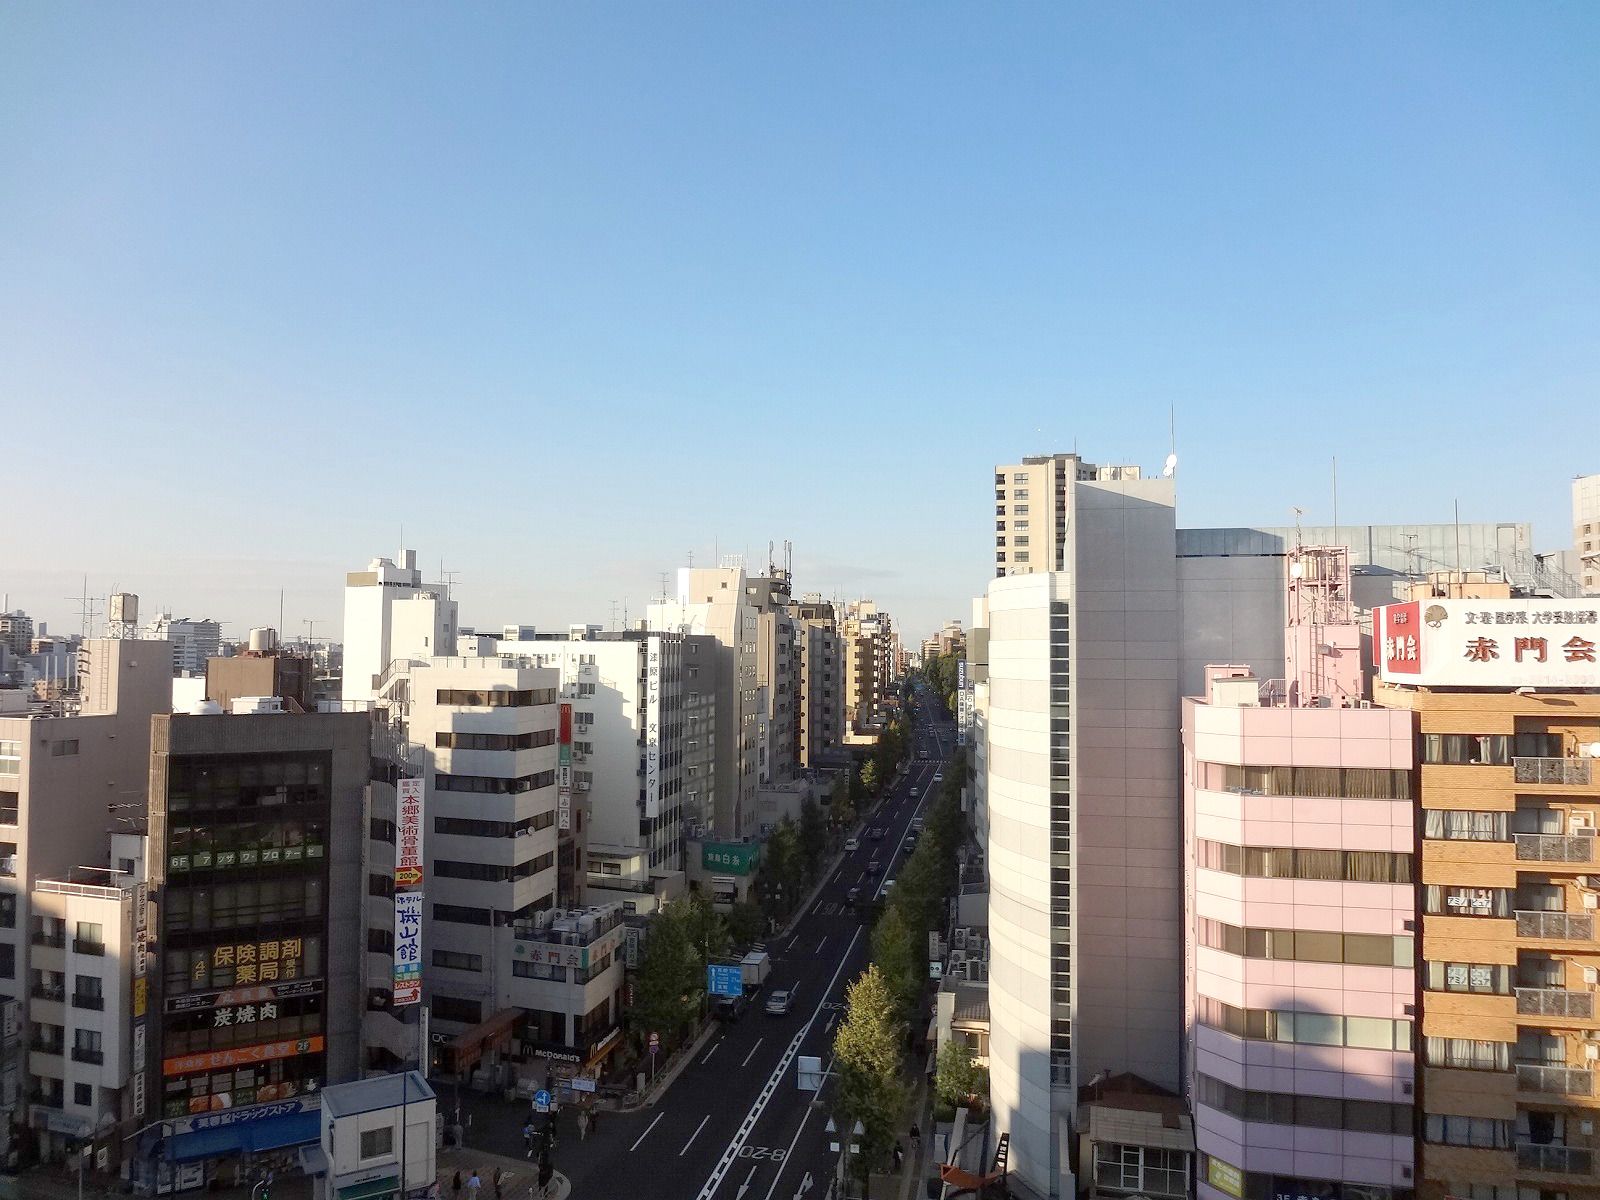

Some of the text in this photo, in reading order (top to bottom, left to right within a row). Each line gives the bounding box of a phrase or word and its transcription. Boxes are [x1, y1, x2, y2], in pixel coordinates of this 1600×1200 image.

[1387, 634, 1416, 661] 赤門会
[1463, 636, 1597, 663] 赤門会
[401, 795, 419, 866] 本郷美術骨董館
[172, 857, 187, 867] 6F
[397, 896, 422, 904] ホテル
[1447, 897, 1491, 907] アミノ ピュア
[213, 938, 302, 968] 保険調剤
[235, 961, 279, 985] 薬局
[213, 1002, 278, 1028] 炭焼肉
[534, 1048, 581, 1063] McDonald's
